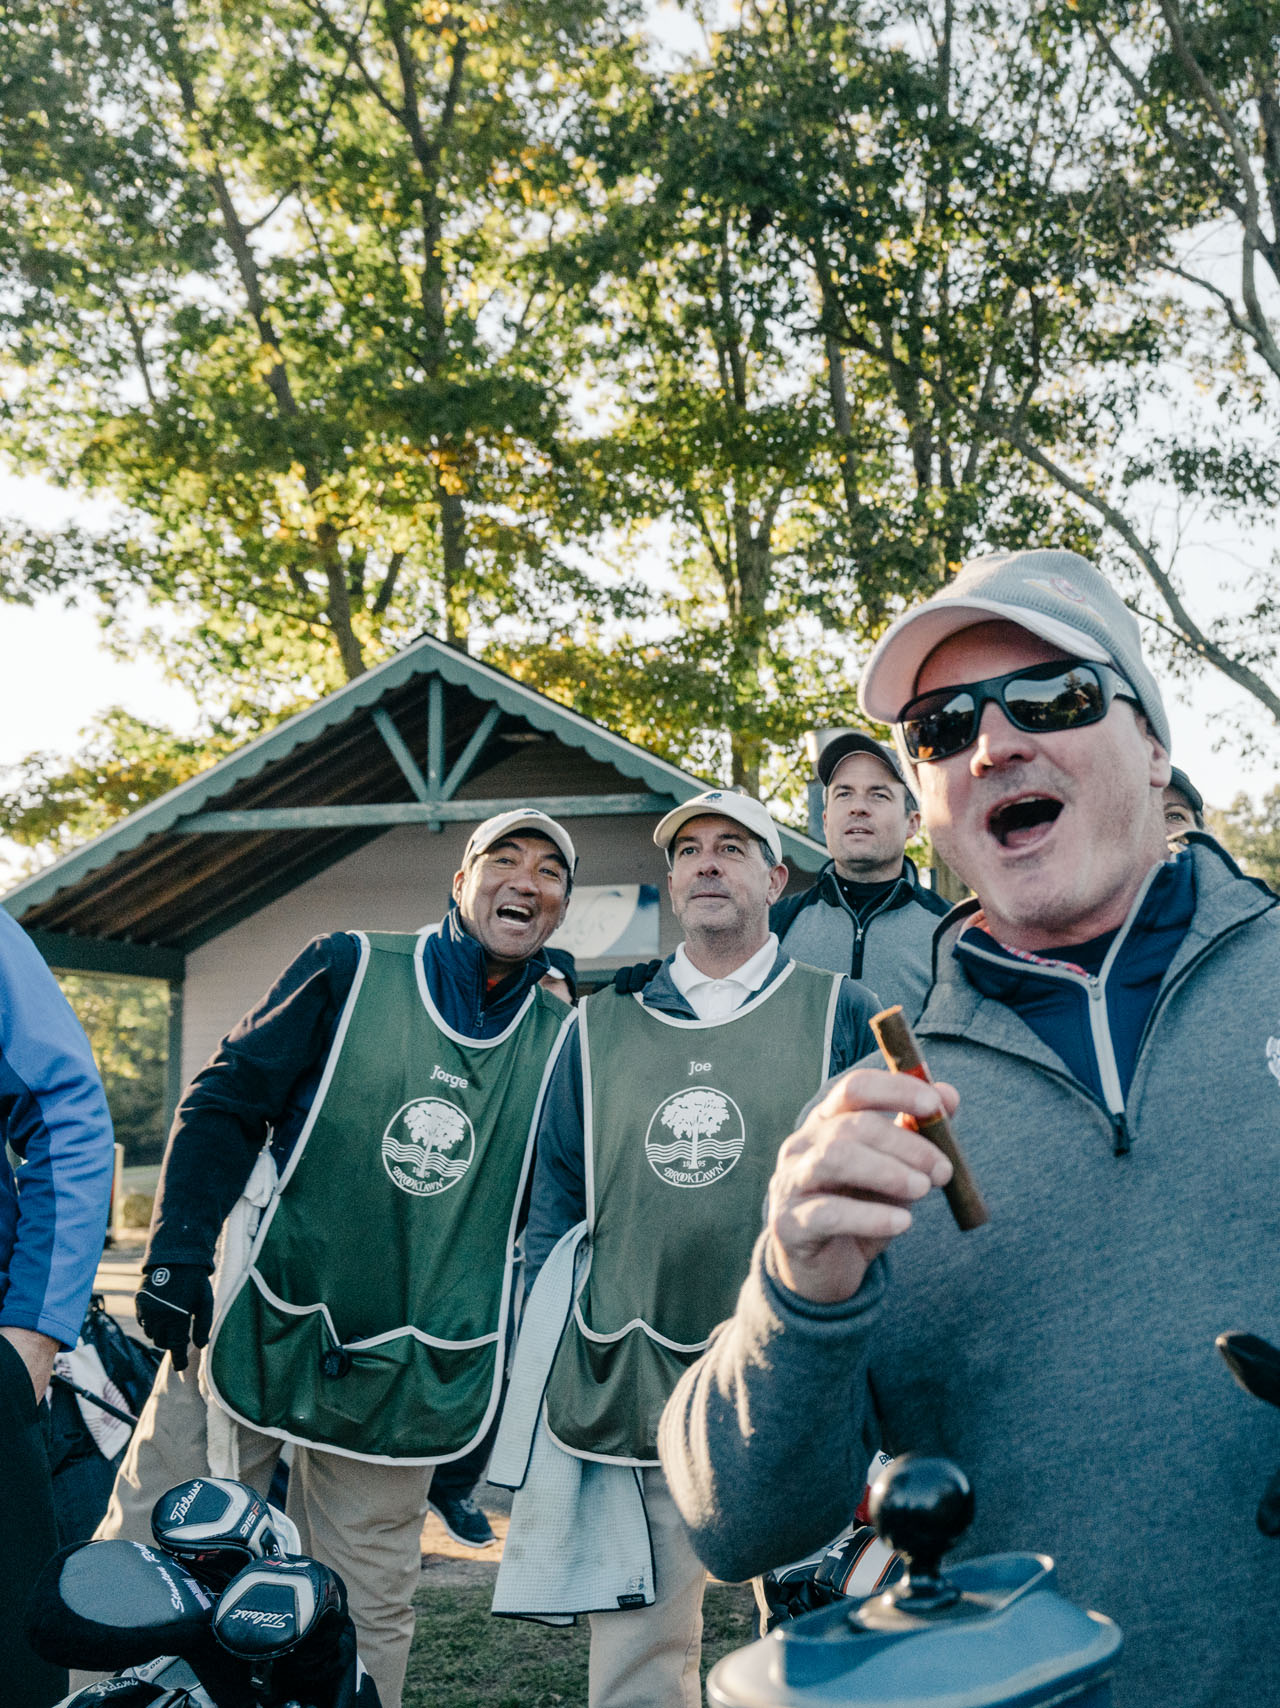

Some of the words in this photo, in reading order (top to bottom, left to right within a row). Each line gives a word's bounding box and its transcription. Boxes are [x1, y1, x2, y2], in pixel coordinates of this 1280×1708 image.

[430, 1065, 469, 1089] Jorge
[688, 1060, 712, 1076] Joe
[392, 1165, 445, 1192] BROOKLAWN
[664, 1161, 725, 1184] BROOKLAWN
[169, 1481, 204, 1525] Titleist
[239, 1501, 261, 1538] 915F
[229, 1608, 294, 1629] Titleist
